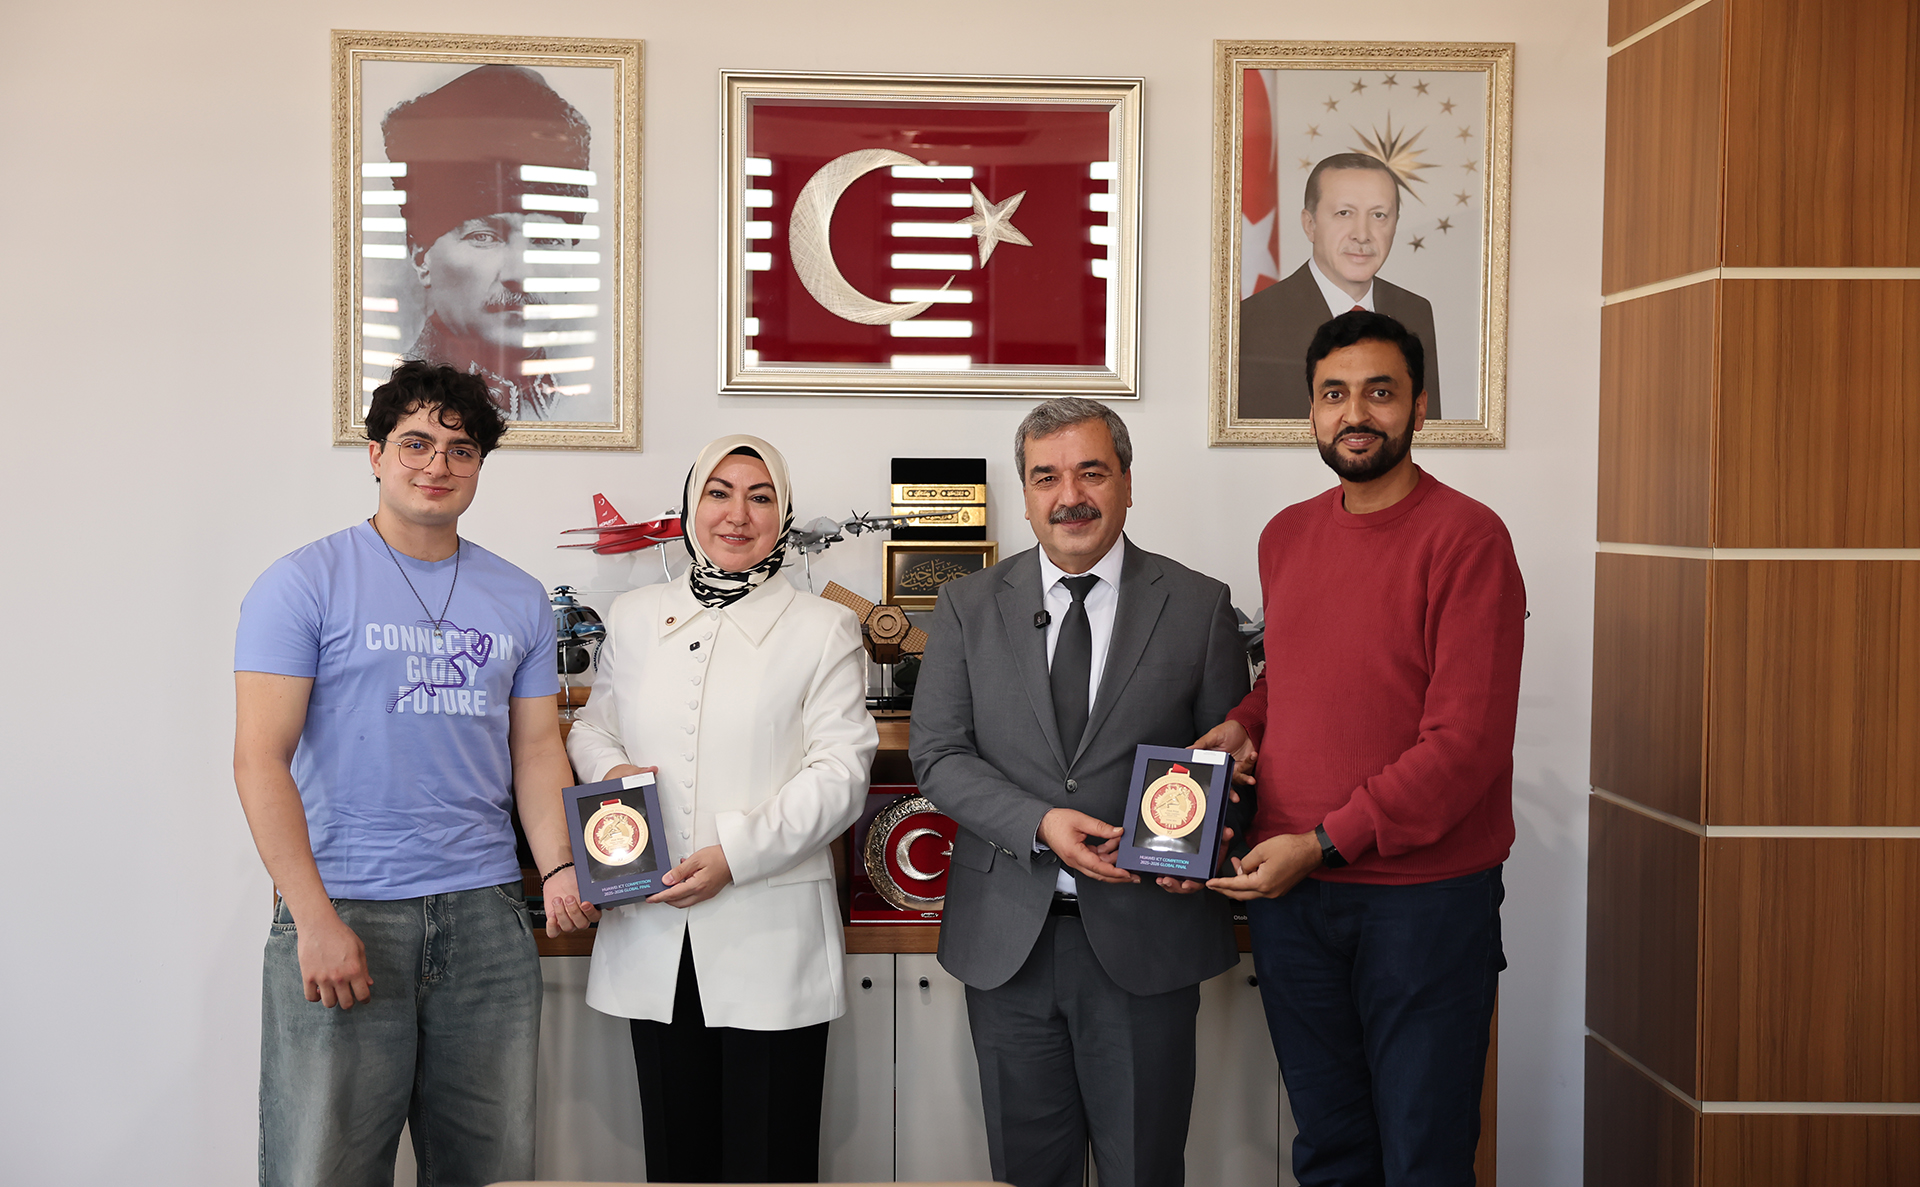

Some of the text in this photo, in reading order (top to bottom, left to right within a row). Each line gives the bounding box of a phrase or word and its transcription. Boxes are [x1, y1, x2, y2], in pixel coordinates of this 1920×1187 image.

[365, 622, 513, 661] CONNECTON
[406, 655, 479, 687] GLORY
[397, 685, 487, 717] FUTURE
[625, 879, 651, 887] COMPETITION
